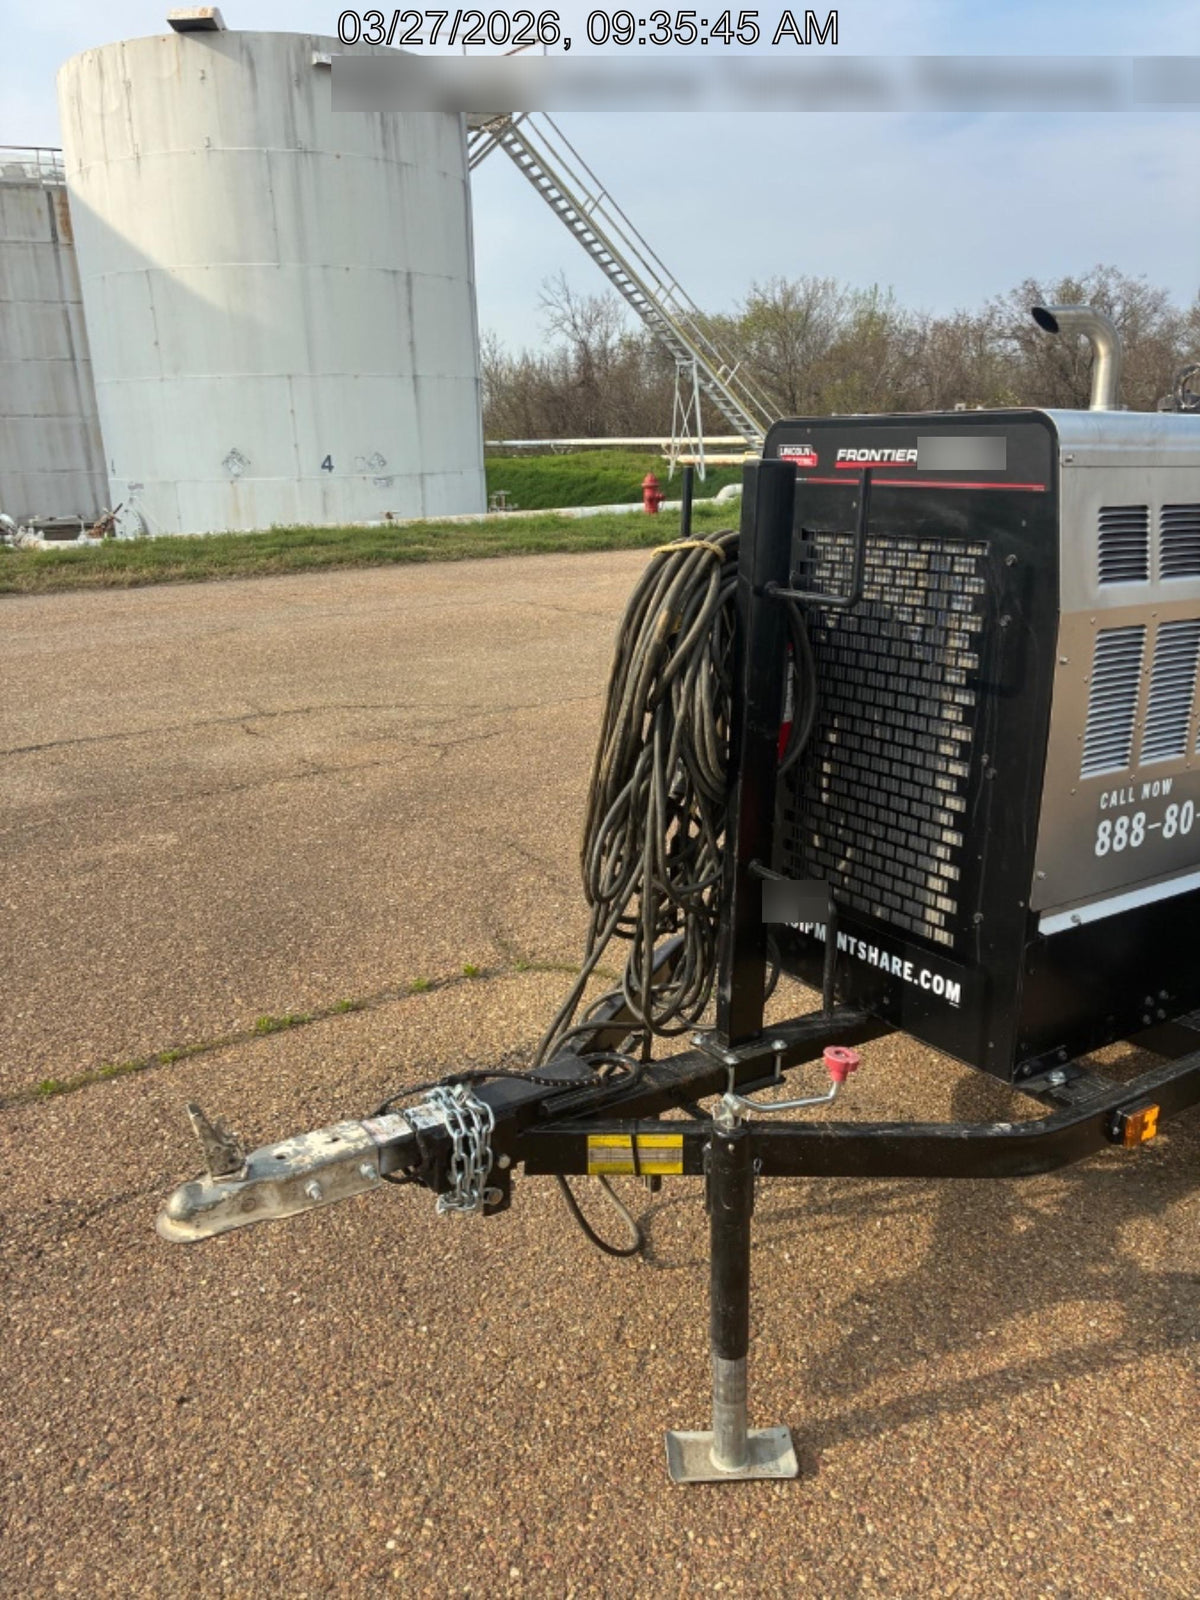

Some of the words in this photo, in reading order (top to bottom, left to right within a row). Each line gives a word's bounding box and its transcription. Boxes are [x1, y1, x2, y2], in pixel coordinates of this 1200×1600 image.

[321, 454, 335, 473] 4
[837, 449, 918, 462] FRONTIER
[1100, 787, 1135, 810] CALL
[1141, 778, 1173, 800] NOW
